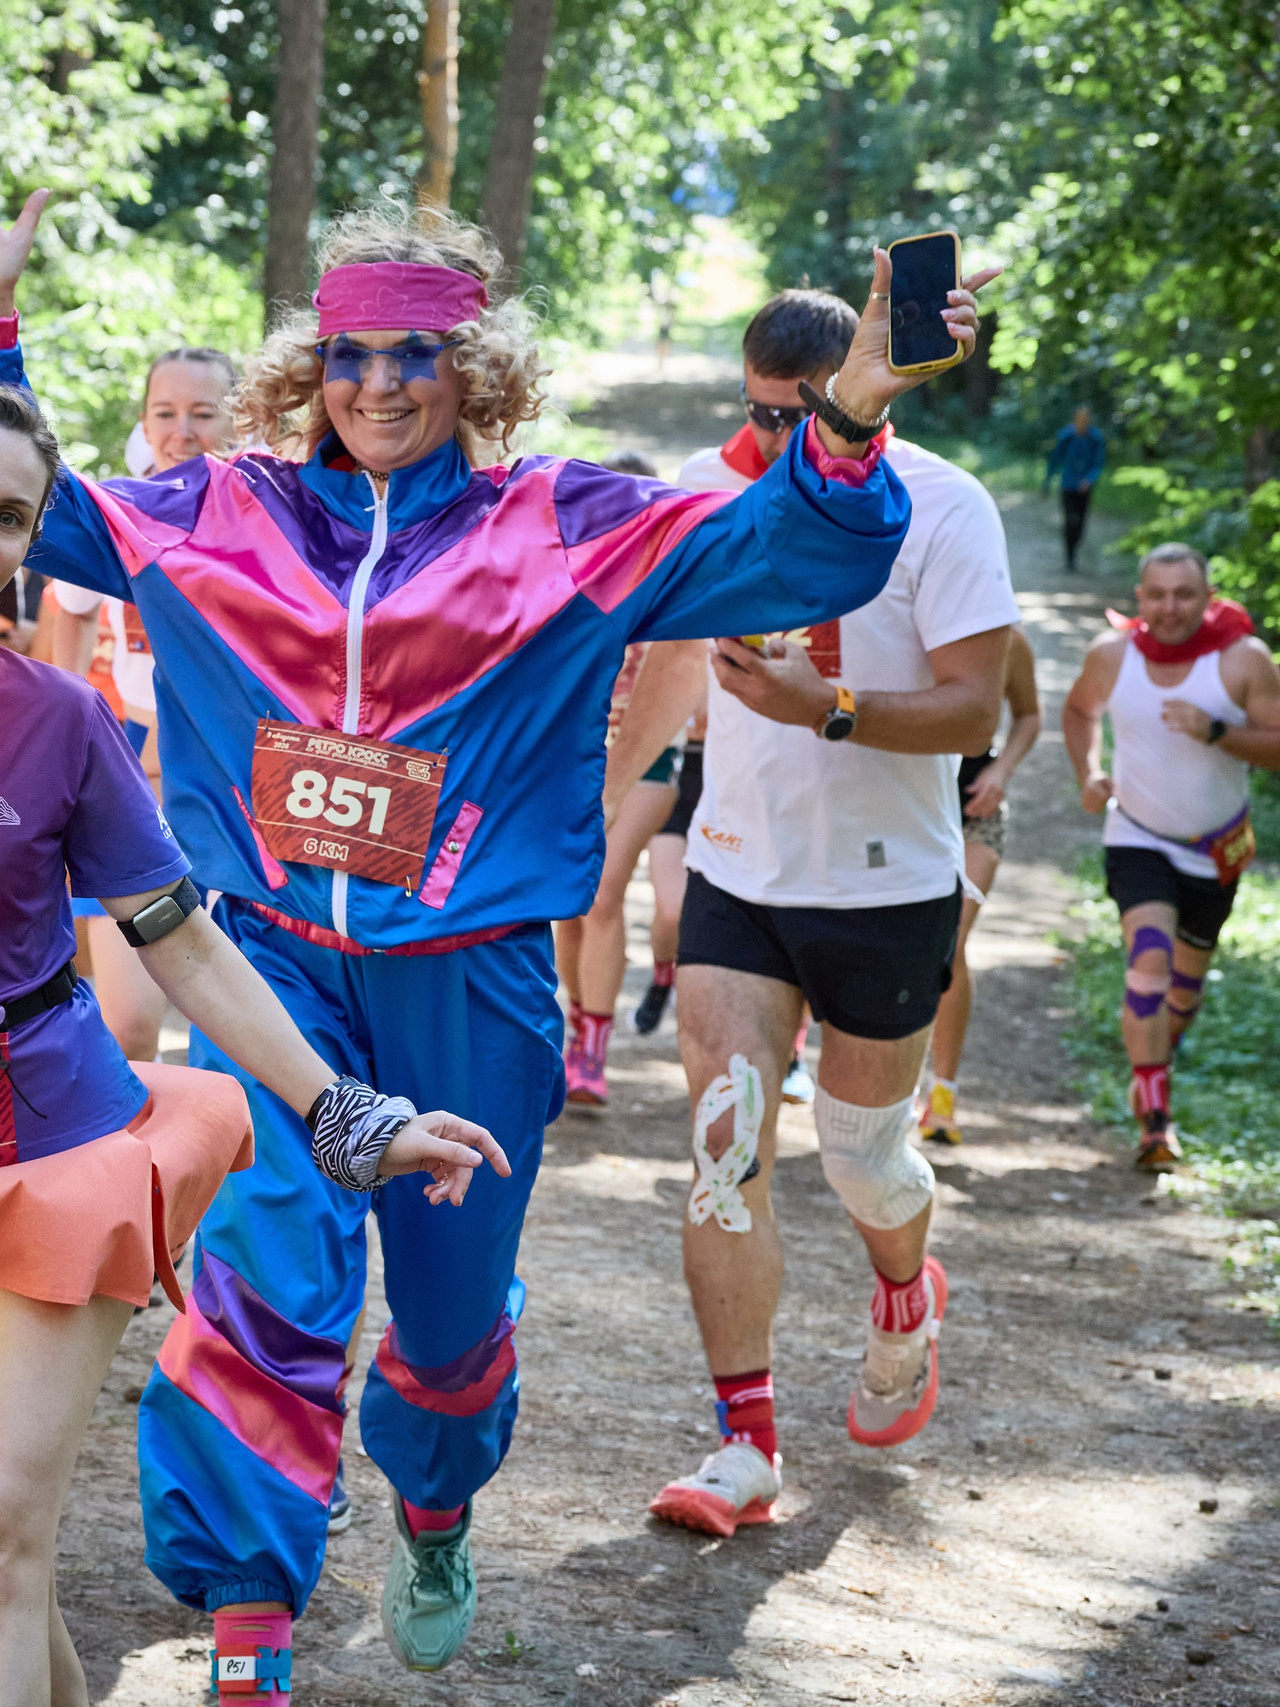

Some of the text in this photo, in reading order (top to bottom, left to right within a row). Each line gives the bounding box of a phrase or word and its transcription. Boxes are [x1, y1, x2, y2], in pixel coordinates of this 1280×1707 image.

[307, 737, 390, 764] РЕТРО КРОСС
[286, 769, 391, 835] 851
[303, 838, 318, 854] 6
